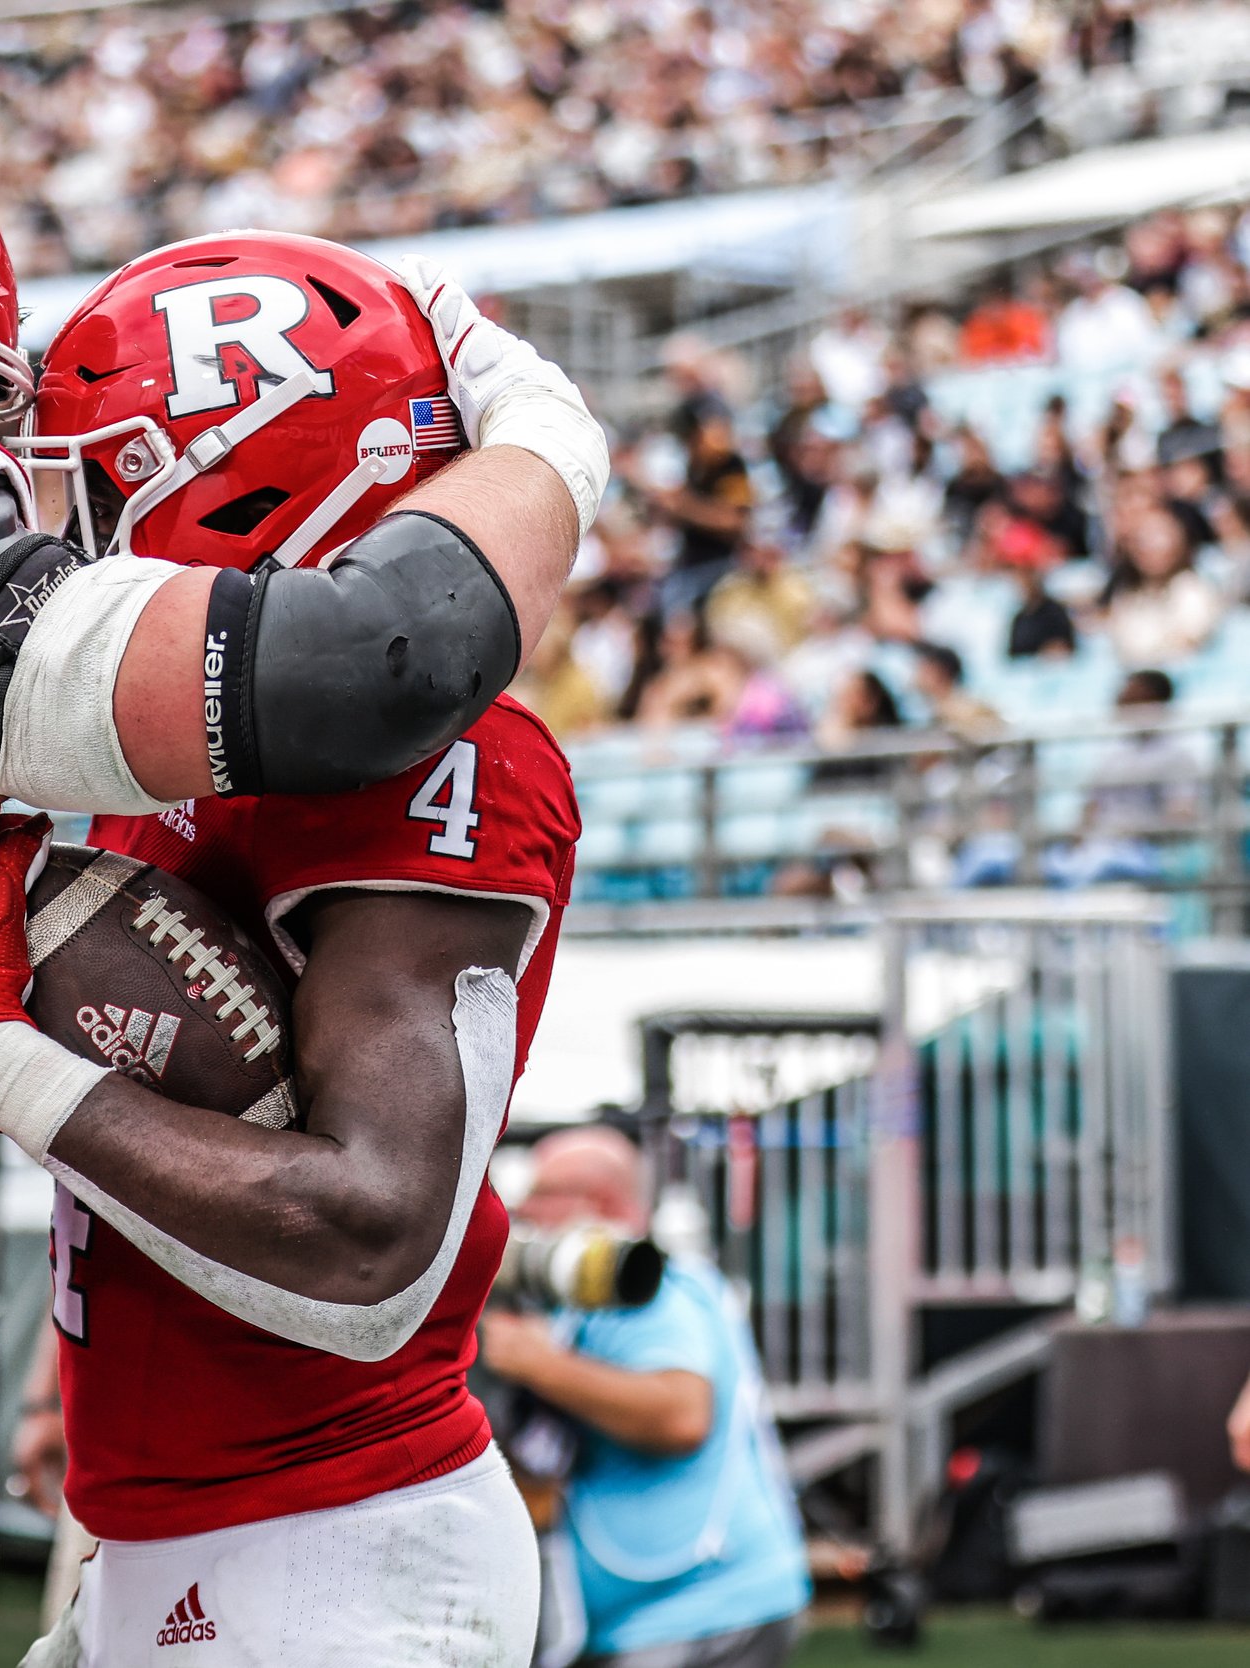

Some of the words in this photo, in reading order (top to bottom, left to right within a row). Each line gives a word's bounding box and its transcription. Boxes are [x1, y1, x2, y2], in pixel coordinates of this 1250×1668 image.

[151, 274, 335, 421] R
[360, 444, 410, 459] BELIEVE
[405, 738, 481, 862] 4
[156, 1620, 216, 1647] adidas
